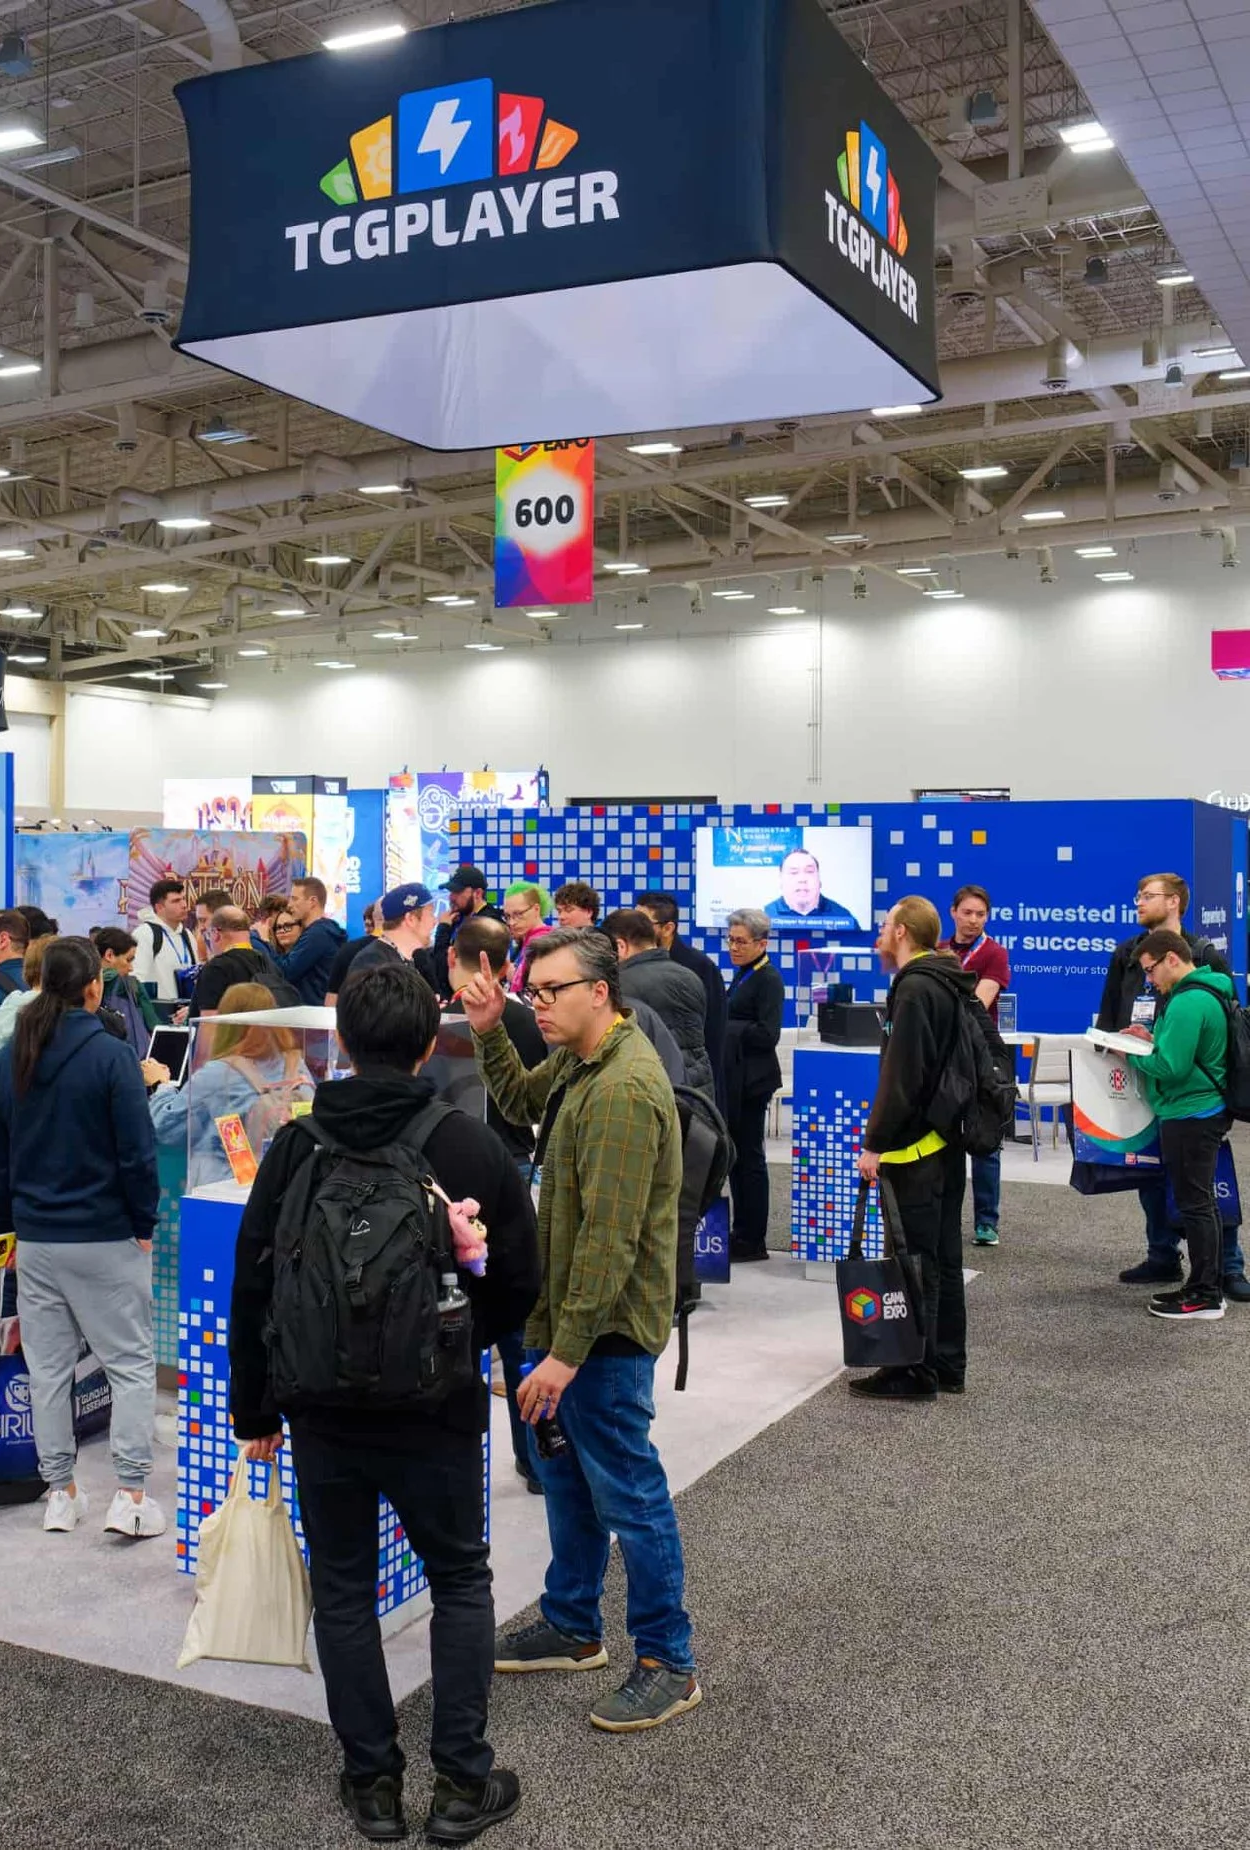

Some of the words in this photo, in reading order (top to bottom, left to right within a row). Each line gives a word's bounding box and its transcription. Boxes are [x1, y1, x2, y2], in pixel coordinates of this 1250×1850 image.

[285, 171, 620, 271] TCGPLAYER
[824, 189, 918, 324] TCGPLAYER
[515, 495, 574, 528] 600
[1018, 902, 1116, 924] invested
[997, 935, 1017, 949] ur
[1022, 935, 1118, 952] success
[1014, 964, 1062, 975] empower
[1064, 966, 1089, 976] your
[1091, 965, 1108, 975] sto
[883, 1305, 908, 1320] EXPO
